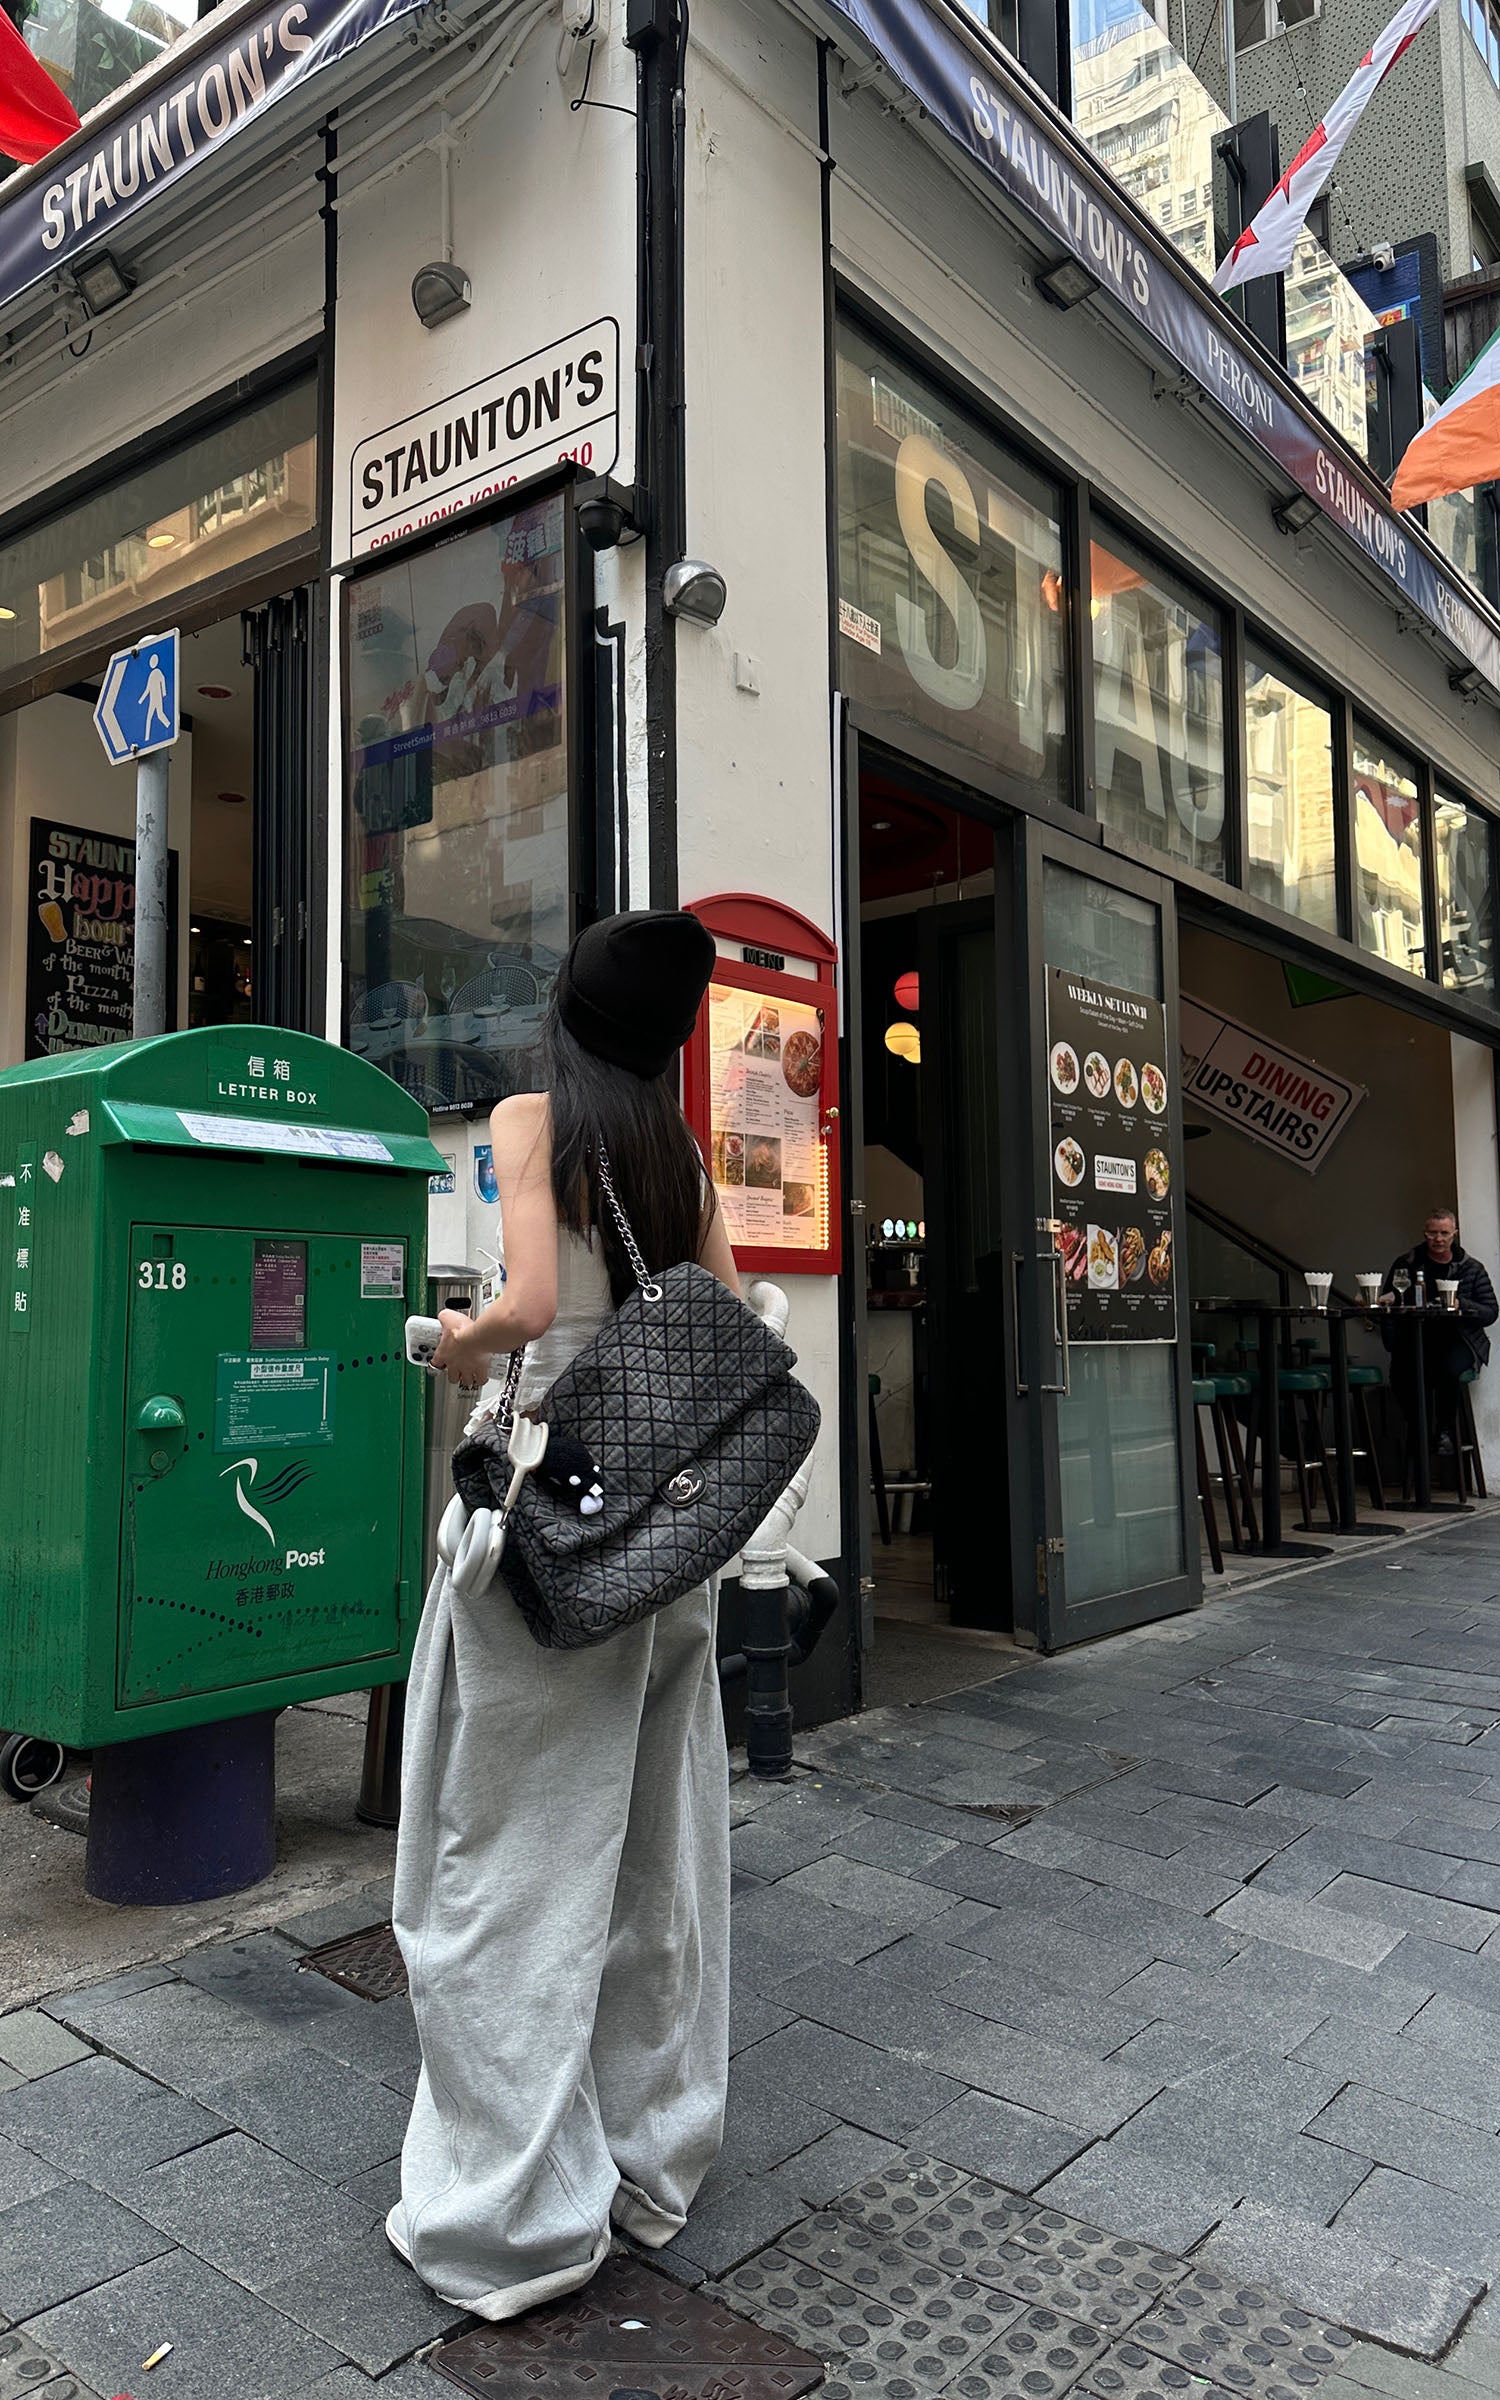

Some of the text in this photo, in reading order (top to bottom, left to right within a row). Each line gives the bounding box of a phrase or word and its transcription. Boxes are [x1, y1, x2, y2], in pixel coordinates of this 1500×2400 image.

[41, 4, 313, 250] STAUNTON'S
[970, 77, 1150, 306] STAUNTON'S
[1207, 327, 1273, 428] PERONI
[1228, 392, 1254, 427] ITALIA
[362, 350, 604, 510] STAUNTON'S
[1315, 449, 1407, 579] STAUNTON'S
[1437, 580, 1475, 644] PERONI
[393, 731, 436, 754] StreetSmart
[42, 953, 57, 972] of
[59, 954, 83, 973] the
[742, 946, 786, 972] MENU
[47, 991, 62, 1011] of
[66, 994, 91, 1012] the
[66, 974, 119, 1001] PIZZA
[1068, 985, 1147, 1020] WEEKLY SET LUNCH
[248, 1055, 291, 1081] 信箱
[218, 1081, 317, 1105] LETTER BOX
[1241, 1052, 1335, 1121] DINING
[432, 1105, 449, 1113] Hotline
[1195, 1063, 1319, 1150] UPSTAIRS
[1096, 1159, 1135, 1178] STAUNTON'S
[14, 1163, 33, 1312] 不准標貼
[138, 1261, 187, 1290] 318
[235, 1581, 295, 1608] 香港郵政
